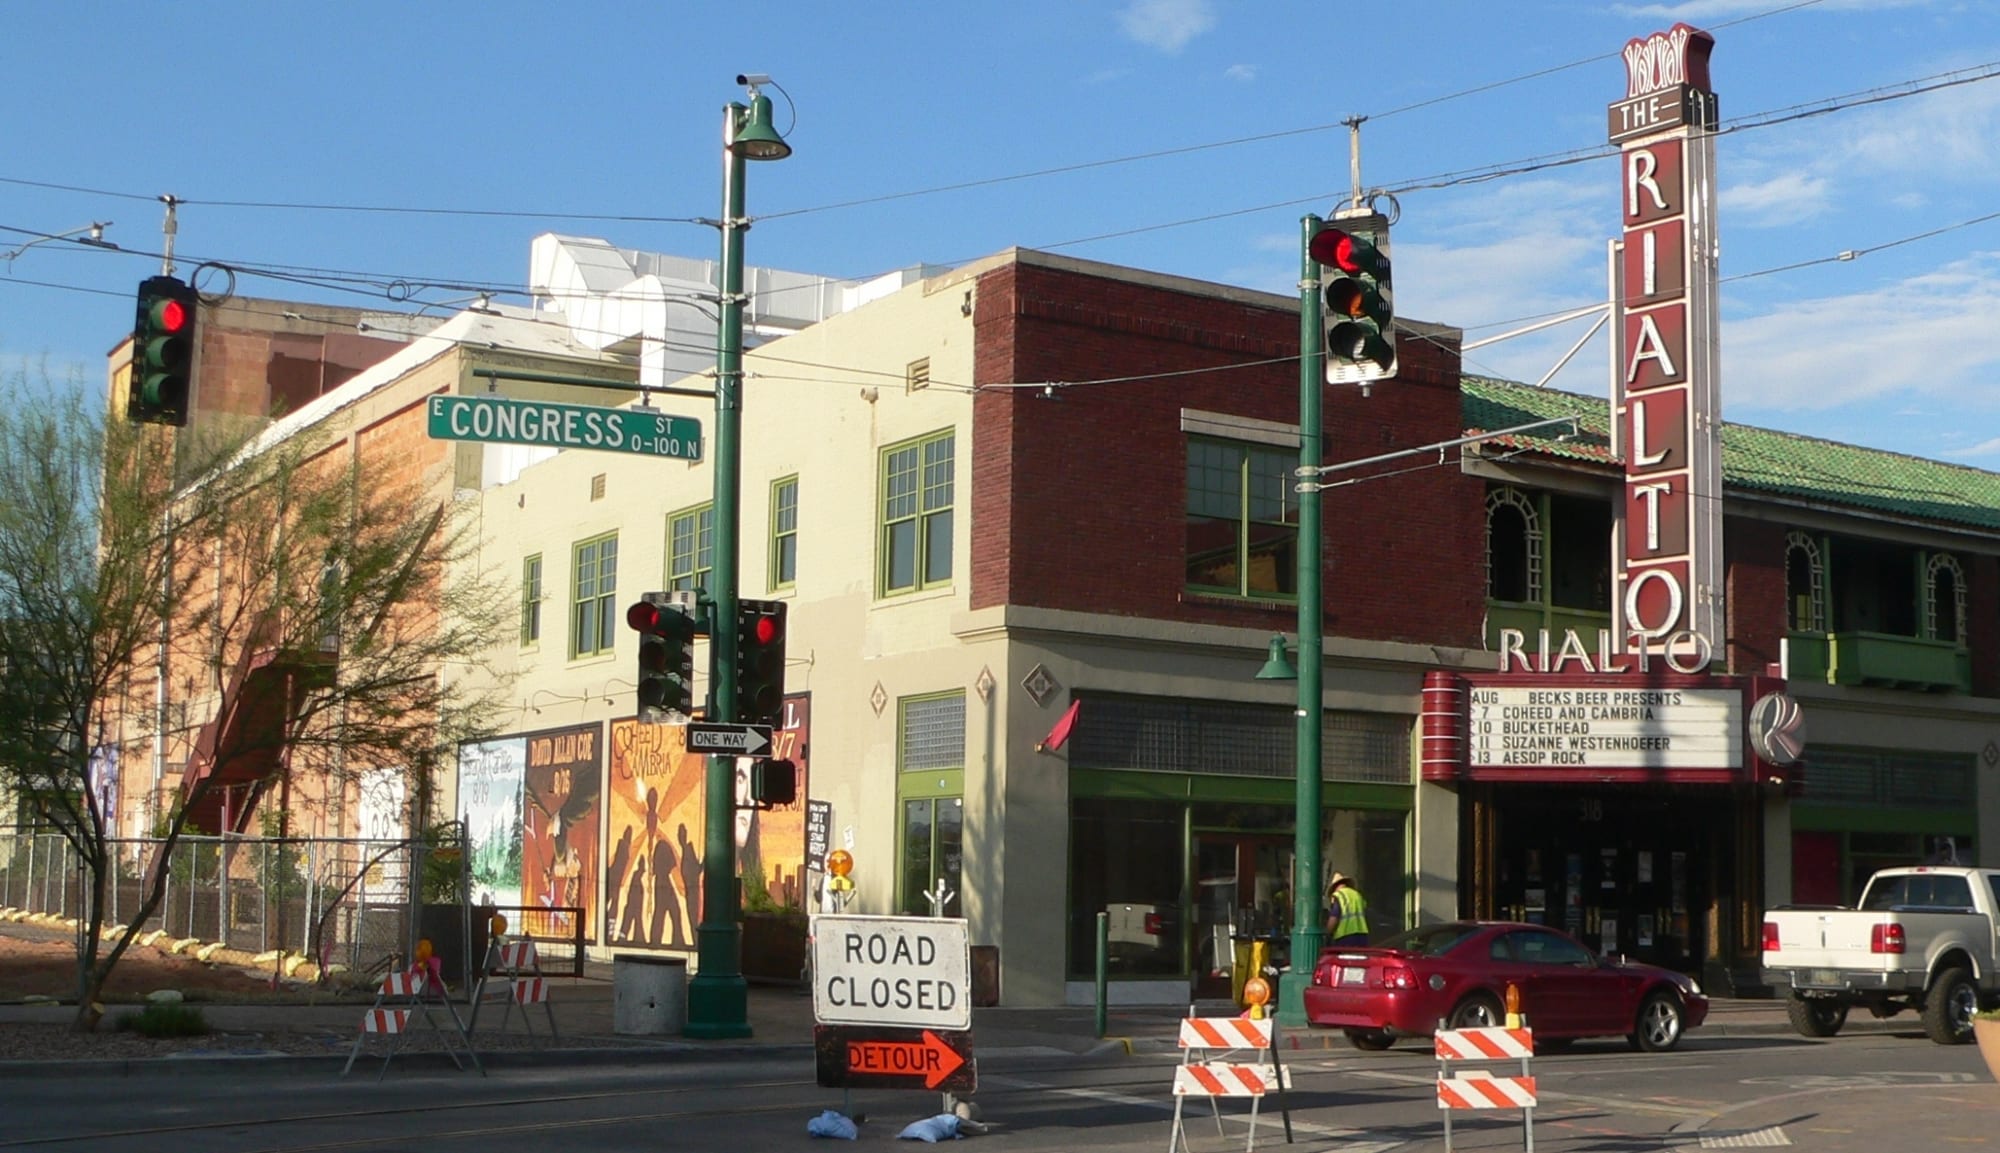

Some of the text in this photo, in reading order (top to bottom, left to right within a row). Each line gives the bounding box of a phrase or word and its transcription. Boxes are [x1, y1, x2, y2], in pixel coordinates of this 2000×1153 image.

[1620, 97, 1660, 130] THE
[1624, 149, 1683, 639] RIALTO
[433, 398, 674, 447] E CONGRESS ST
[631, 434, 697, 458] 0-100 N
[1500, 628, 1712, 674] RIALTO
[1471, 691, 1681, 706] AUG BECKS BEER PRESENTS
[1481, 706, 1654, 720] 7 COHEED AND CAMBRIA
[695, 733, 747, 746] ONE WAY
[1479, 721, 1589, 735] 10 BUCKETHEAD
[530, 738, 552, 767] DAVID
[553, 735, 576, 765] ALLAN
[577, 732, 594, 761] COE
[1480, 736, 1670, 750] 11 SUZANNE WESTENHOEFER
[621, 746, 672, 780] CAMBRIA
[1478, 751, 1586, 765] 13 AESOP ROCK
[845, 933, 936, 966] ROAD
[827, 975, 956, 1011] CLOSED
[849, 1046, 940, 1071] DETOUR
